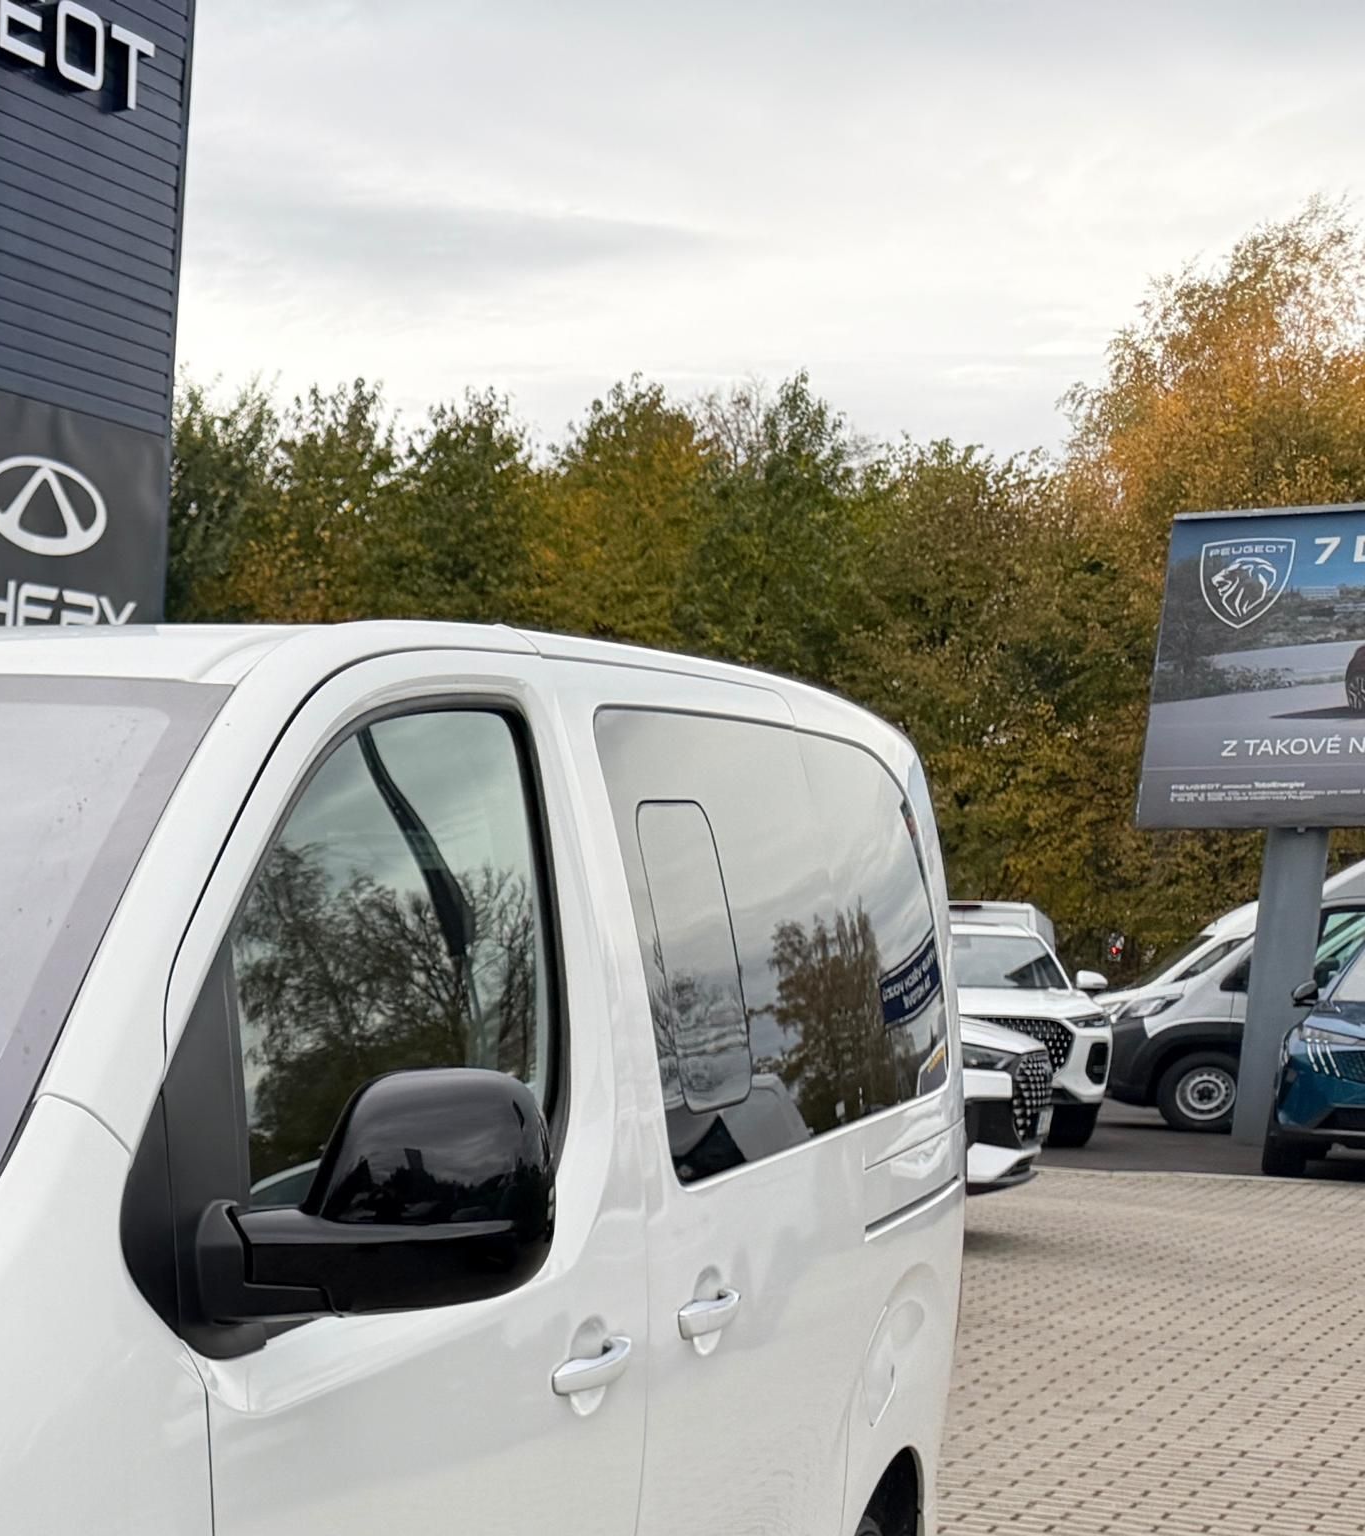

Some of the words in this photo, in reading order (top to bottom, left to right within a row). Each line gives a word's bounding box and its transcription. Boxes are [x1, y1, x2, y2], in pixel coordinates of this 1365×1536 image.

[1209, 544, 1287, 557] PEUGEOT
[1315, 536, 1341, 565] 7
[1221, 740, 1238, 756] Z
[1244, 734, 1342, 756] TAKOVÉ
